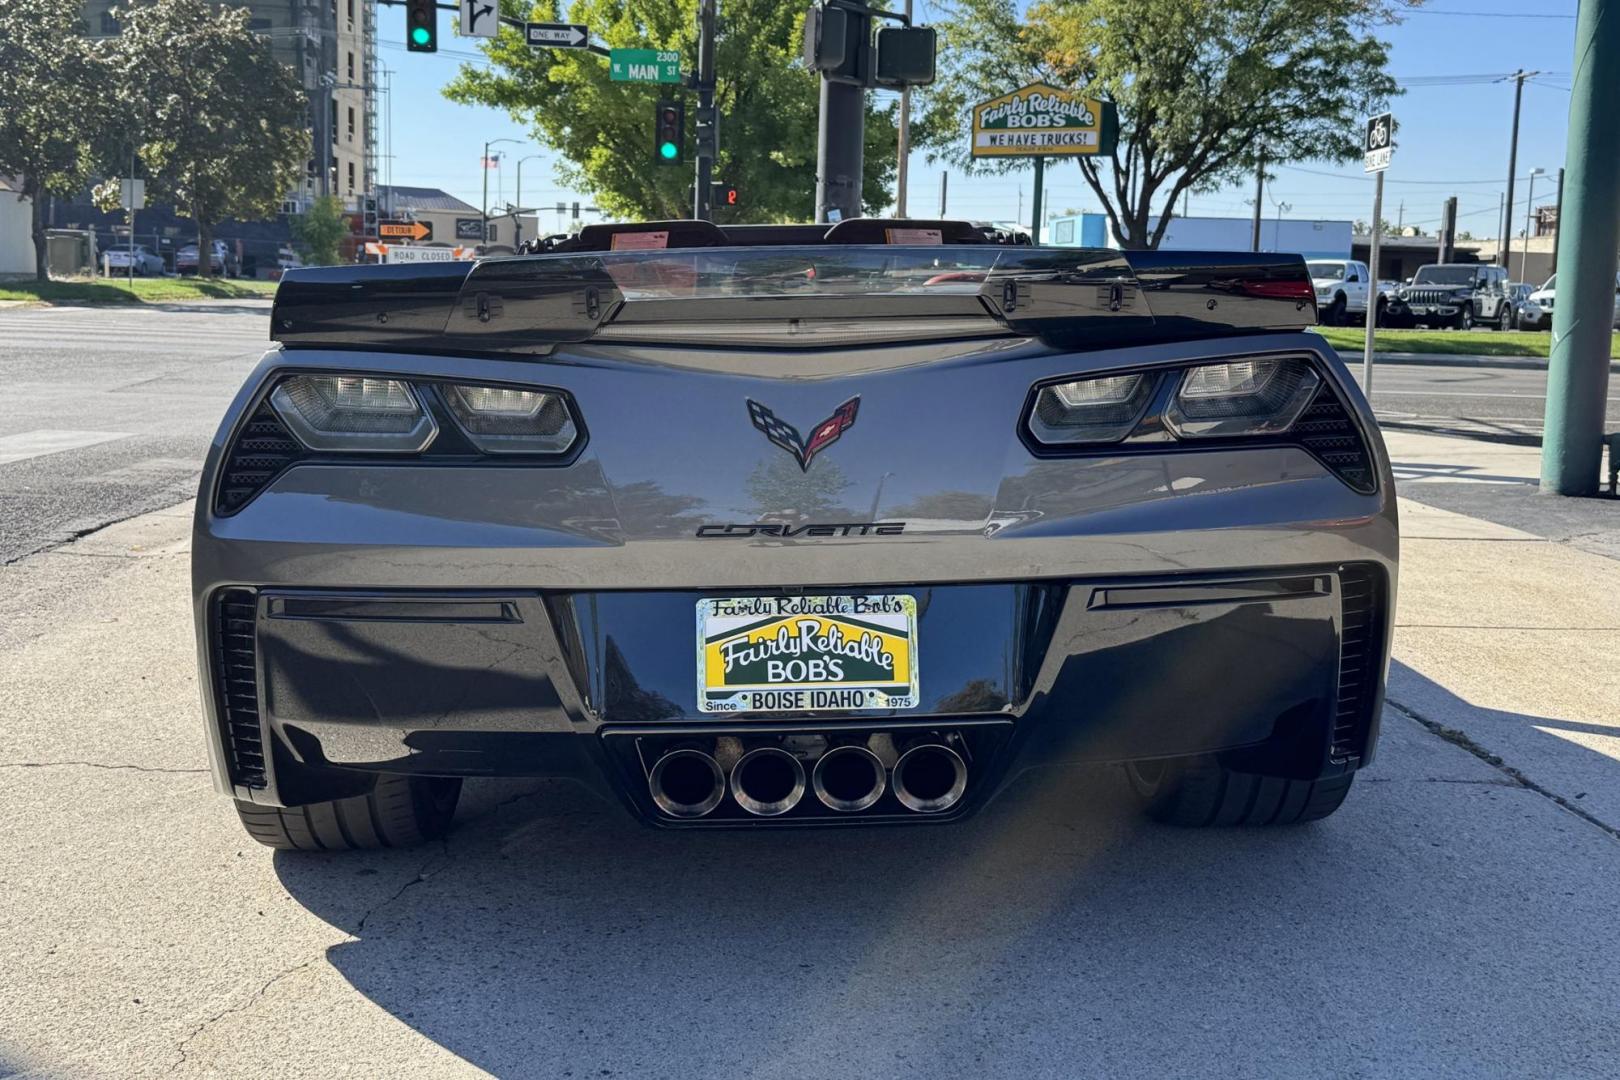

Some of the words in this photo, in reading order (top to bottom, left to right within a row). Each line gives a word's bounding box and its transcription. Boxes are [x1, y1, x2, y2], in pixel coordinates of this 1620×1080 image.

[533, 31, 550, 39] ONE
[656, 52, 678, 62] 2300
[628, 64, 659, 80] MAIN
[667, 66, 676, 75] ST
[980, 96, 1029, 128] Fairly
[1028, 93, 1094, 126] Reliable
[1007, 113, 1066, 128] BOB'S
[989, 134, 1004, 145] WE
[1008, 134, 1036, 145] HAVE
[1041, 133, 1088, 145] TRUCKS!
[386, 225, 412, 234] DETOUR
[394, 252, 415, 260] ROAD
[421, 252, 451, 261] CLOSED
[696, 522, 906, 538] CORVETTE
[710, 597, 772, 617] Fairly
[774, 597, 849, 616] Reliable
[851, 595, 903, 615] Bob's
[719, 624, 800, 673] Fairly
[796, 618, 894, 671] Reliable
[767, 655, 844, 683] BOB'S
[705, 701, 737, 711] Since
[752, 690, 805, 710] BOISE
[810, 690, 864, 709] IDAHO
[885, 698, 911, 707] 1975
